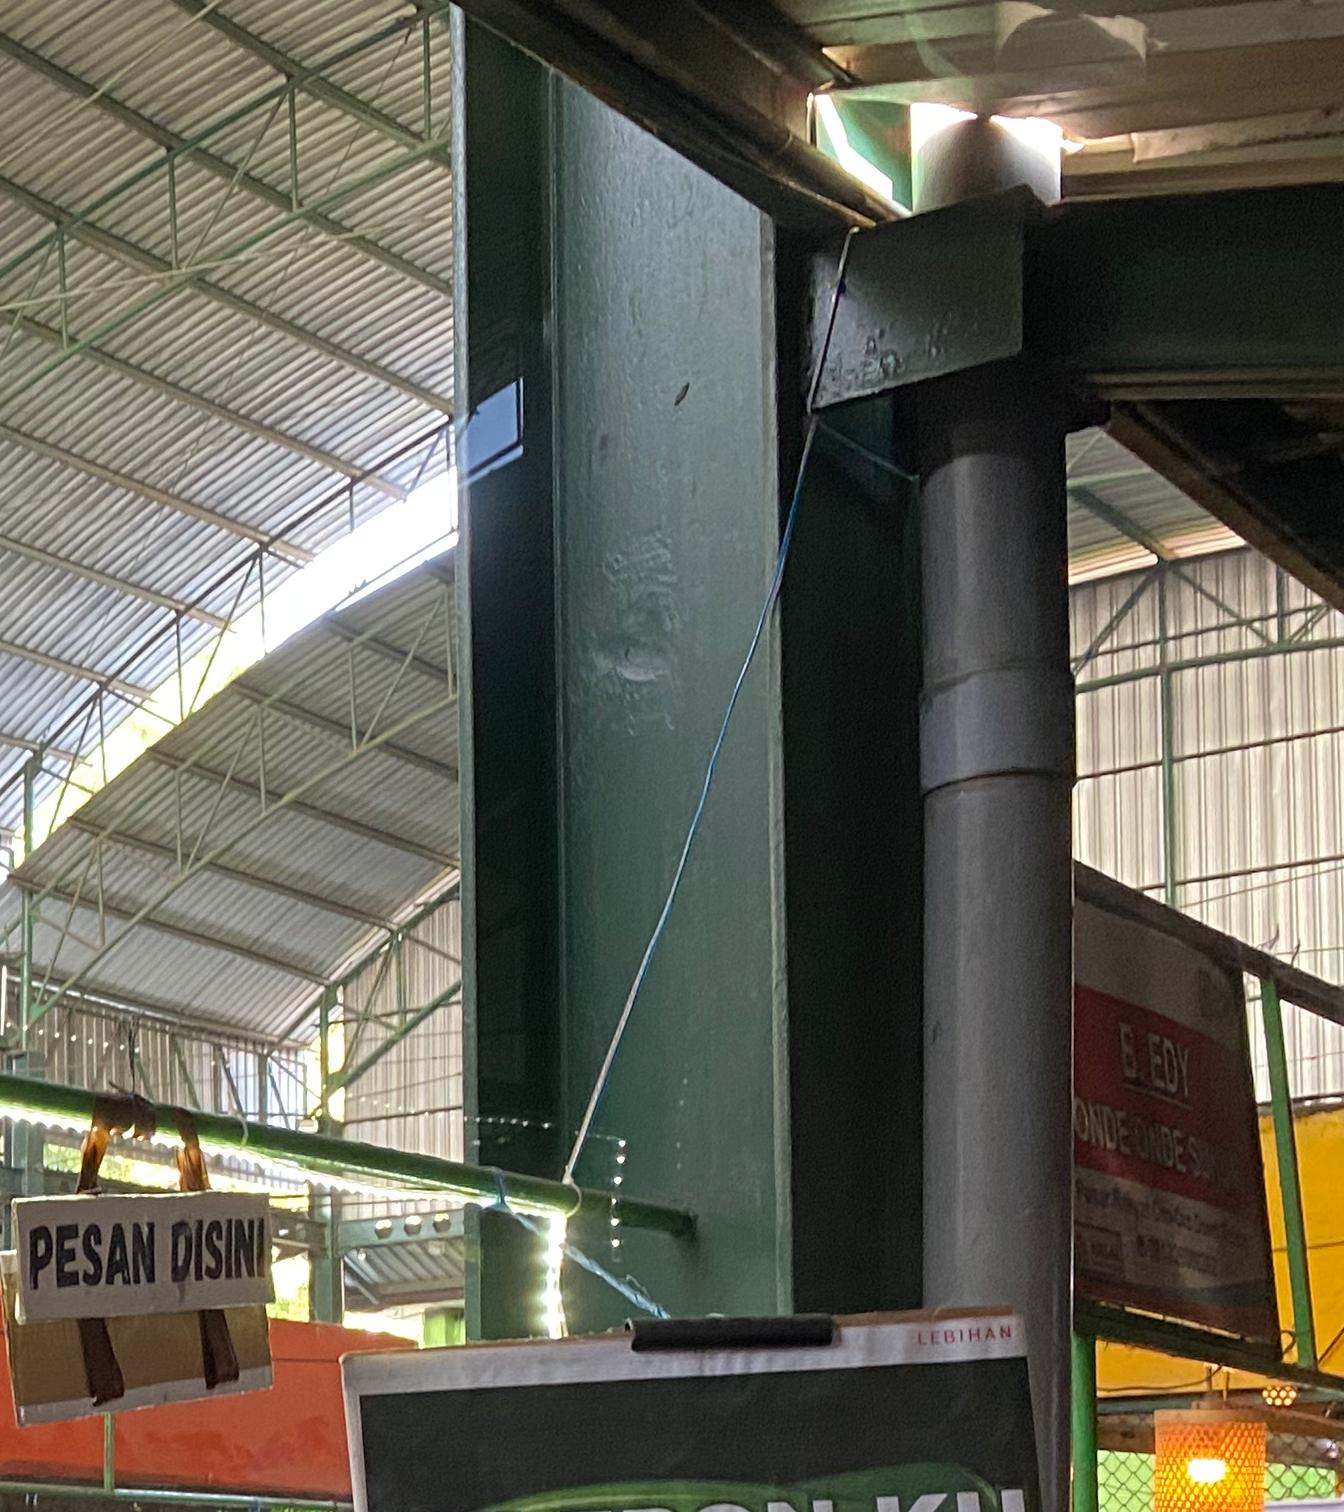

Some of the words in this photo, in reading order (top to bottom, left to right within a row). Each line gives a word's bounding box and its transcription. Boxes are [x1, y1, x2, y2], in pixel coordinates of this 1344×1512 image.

[28, 1219, 156, 1291] PESAN
[170, 1216, 266, 1284] DISINI
[916, 1325, 1012, 1345] LEBIHAN
